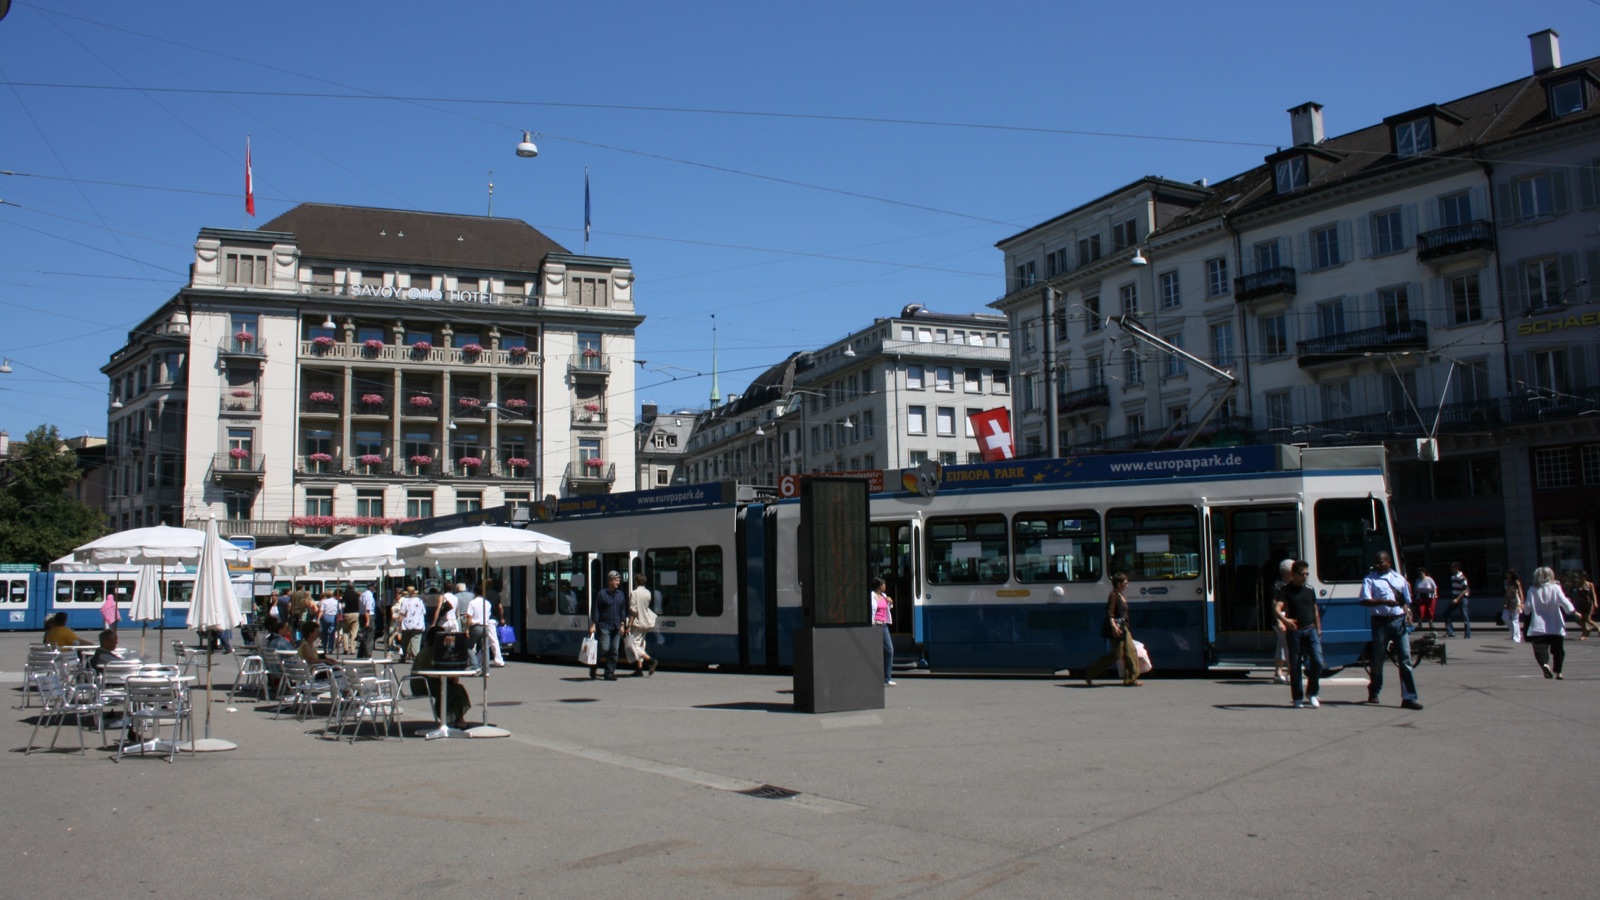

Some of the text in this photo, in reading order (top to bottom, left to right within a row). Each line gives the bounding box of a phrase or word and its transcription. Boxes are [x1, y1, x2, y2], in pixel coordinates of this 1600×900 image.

[351, 284, 496, 304] SAVOY HOTEL
[1517, 312, 1600, 335] SCHAE
[1110, 454, 1242, 472] www.europapark.de
[946, 467, 1025, 482] EUROPA PARK
[781, 476, 795, 496] 6
[637, 489, 704, 504] www.europapark.de
